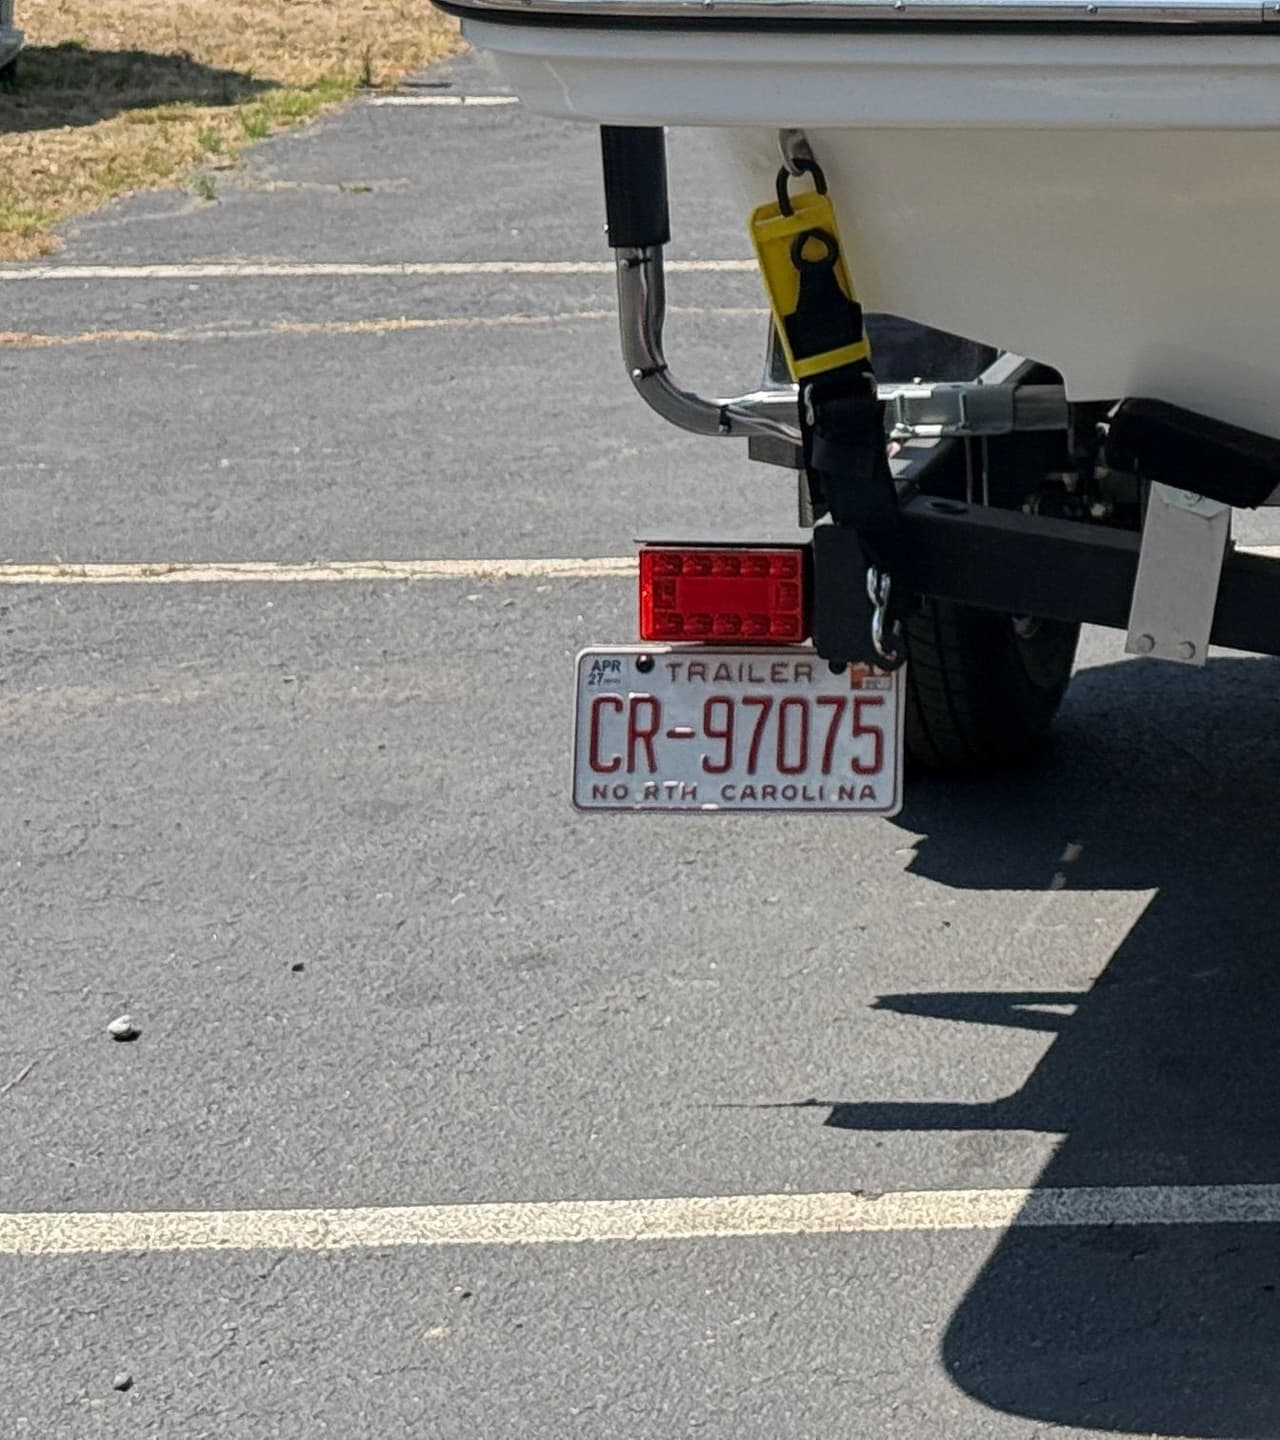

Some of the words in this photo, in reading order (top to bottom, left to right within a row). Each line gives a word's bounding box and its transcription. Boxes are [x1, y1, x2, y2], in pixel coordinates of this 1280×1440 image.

[591, 660, 622, 673] APR
[666, 662, 813, 684] TRAILER
[589, 692, 885, 776] CR-97075
[591, 781, 698, 802] NORTH
[720, 782, 878, 802] CAROLINA
